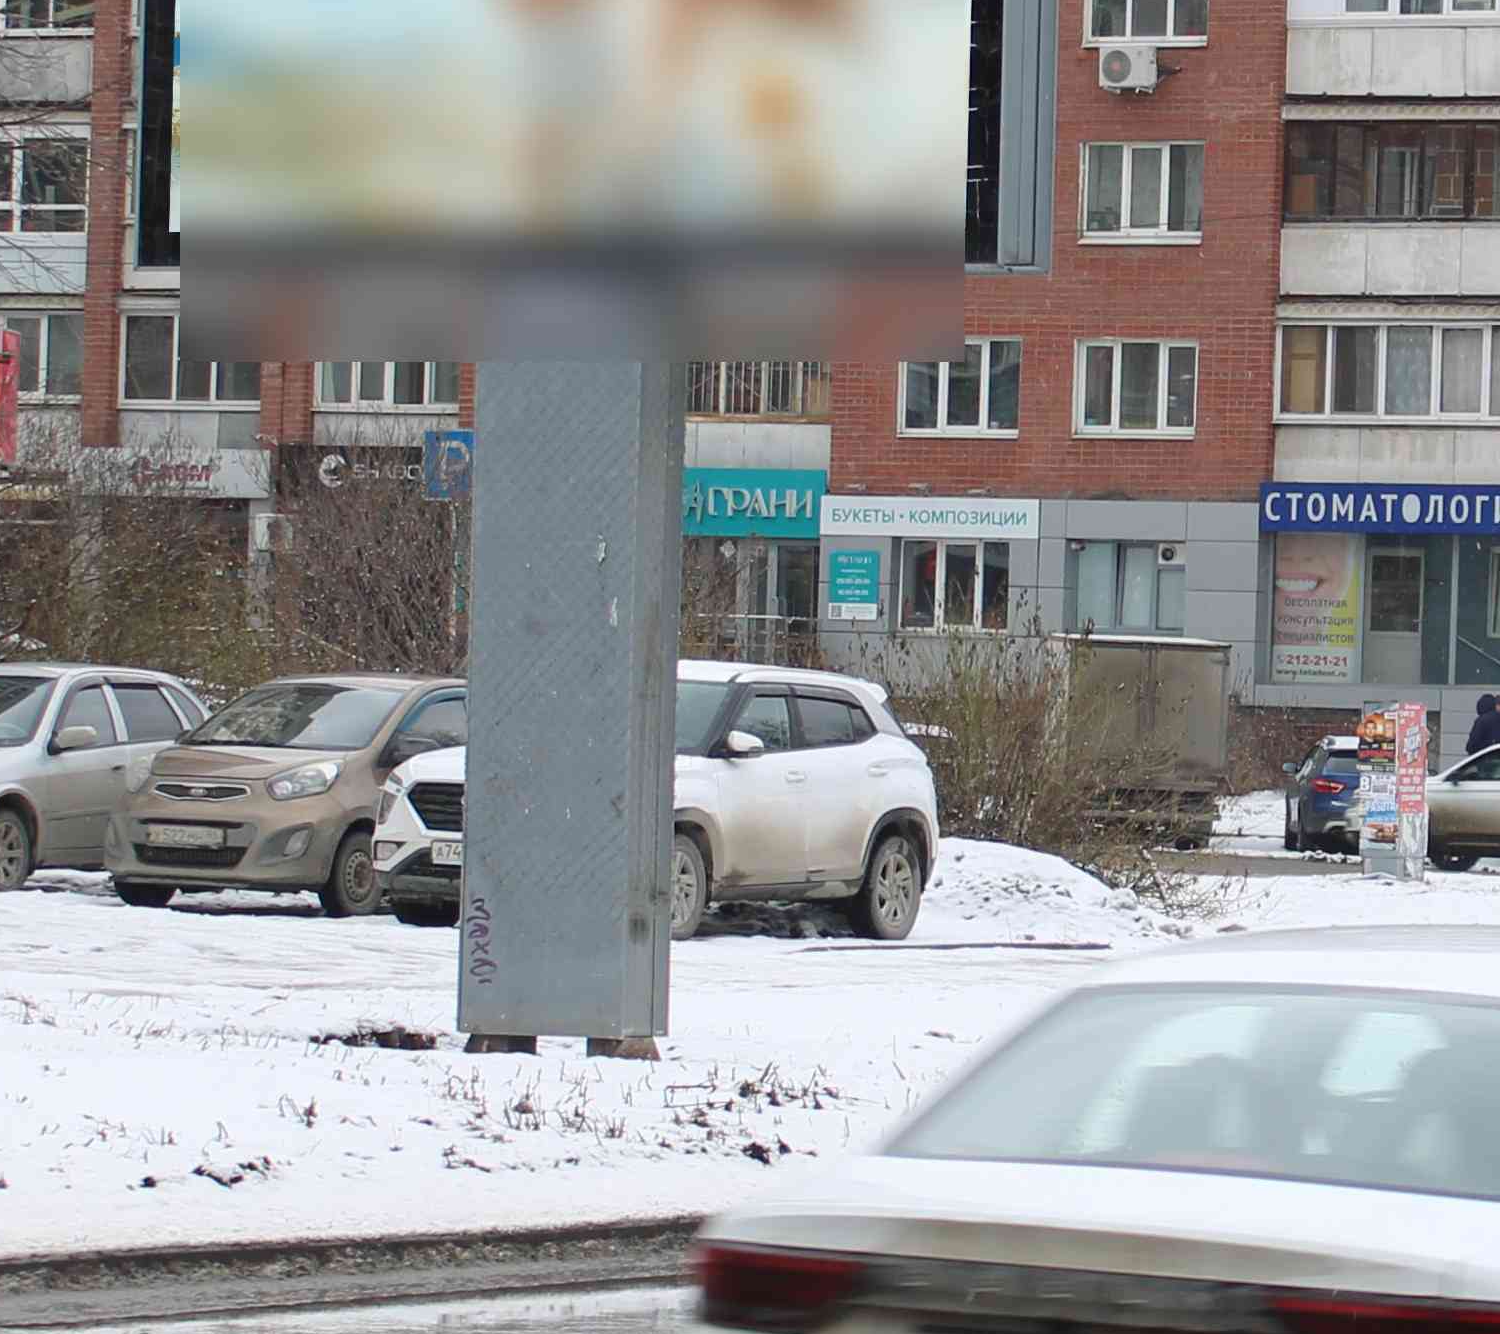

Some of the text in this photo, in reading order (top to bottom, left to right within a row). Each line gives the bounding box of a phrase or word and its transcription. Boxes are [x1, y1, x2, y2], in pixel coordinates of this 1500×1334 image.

[831, 507, 1028, 527] БУКЕТЫ КОМПОЗИЦИИ
[1286, 653, 1348, 667] 212-21-21
